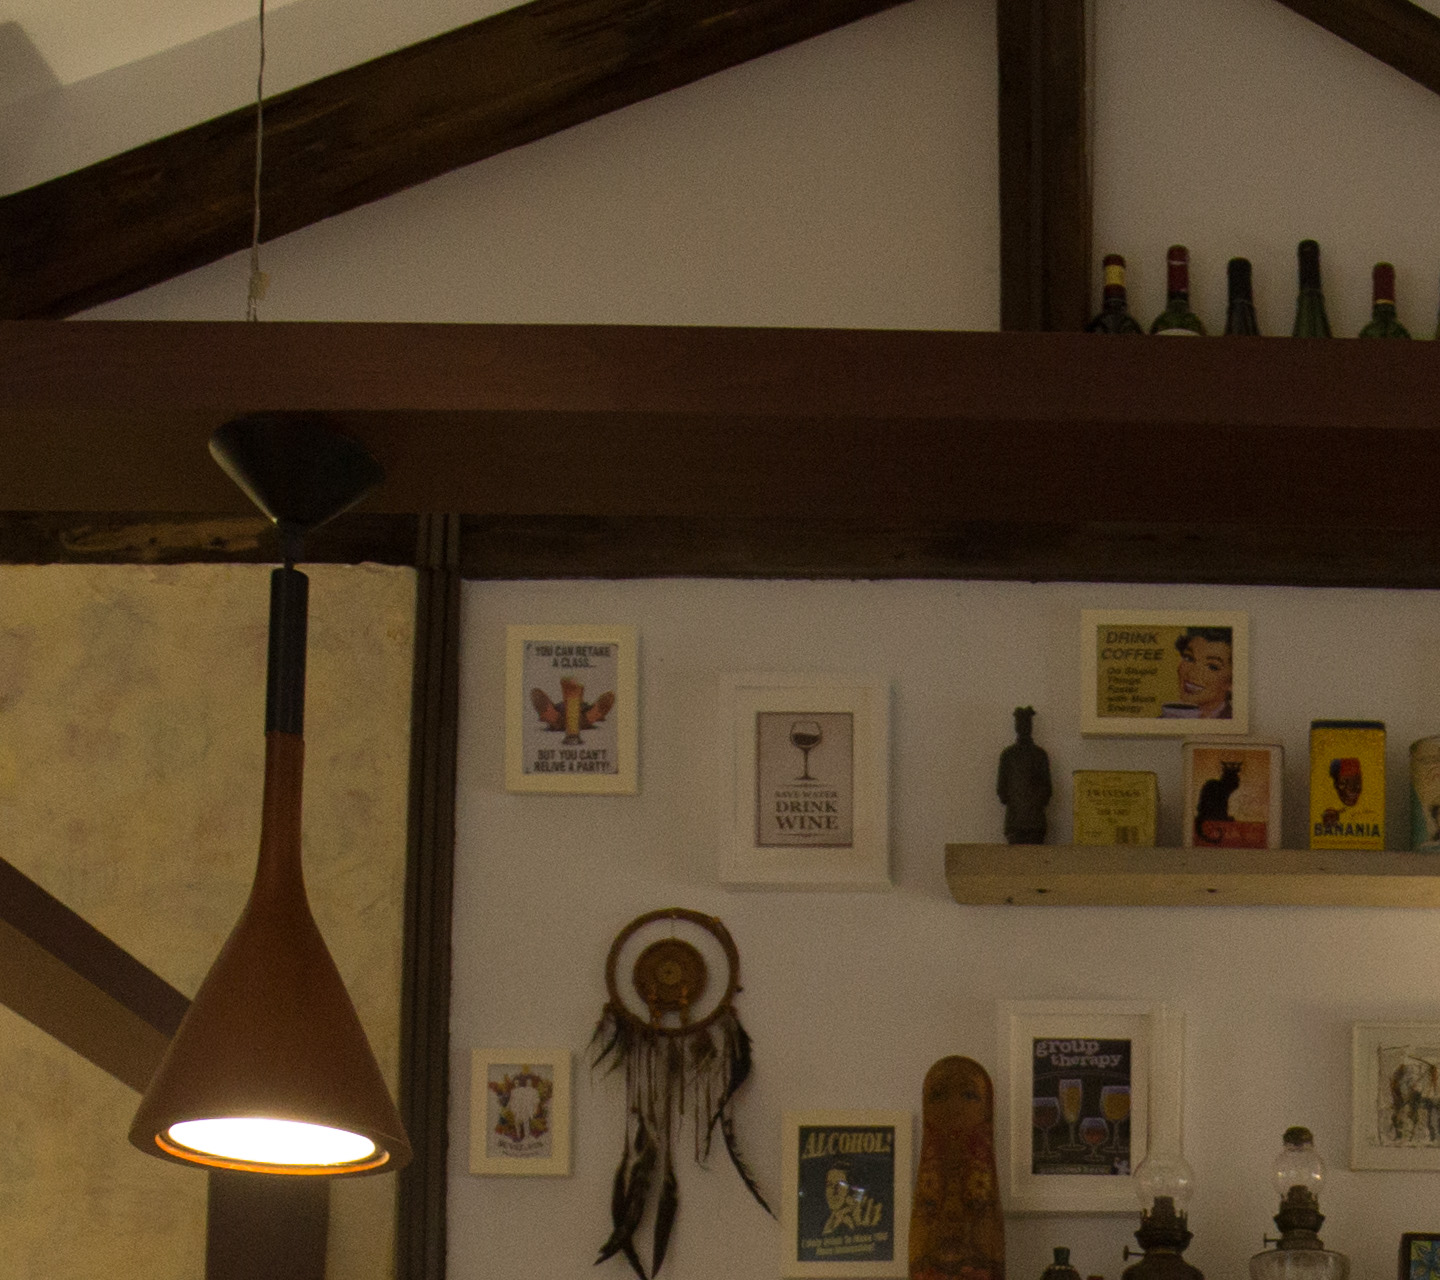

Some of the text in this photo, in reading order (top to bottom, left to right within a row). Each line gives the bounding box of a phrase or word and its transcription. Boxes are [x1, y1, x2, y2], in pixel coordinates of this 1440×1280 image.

[1105, 631, 1159, 644] DRINK
[1101, 648, 1165, 661] COFFEE
[774, 800, 839, 814] DRINK
[774, 815, 840, 831] WINE
[1313, 823, 1382, 837] BANANIA
[1035, 1039, 1100, 1058] group
[1050, 1053, 1123, 1068] therapy
